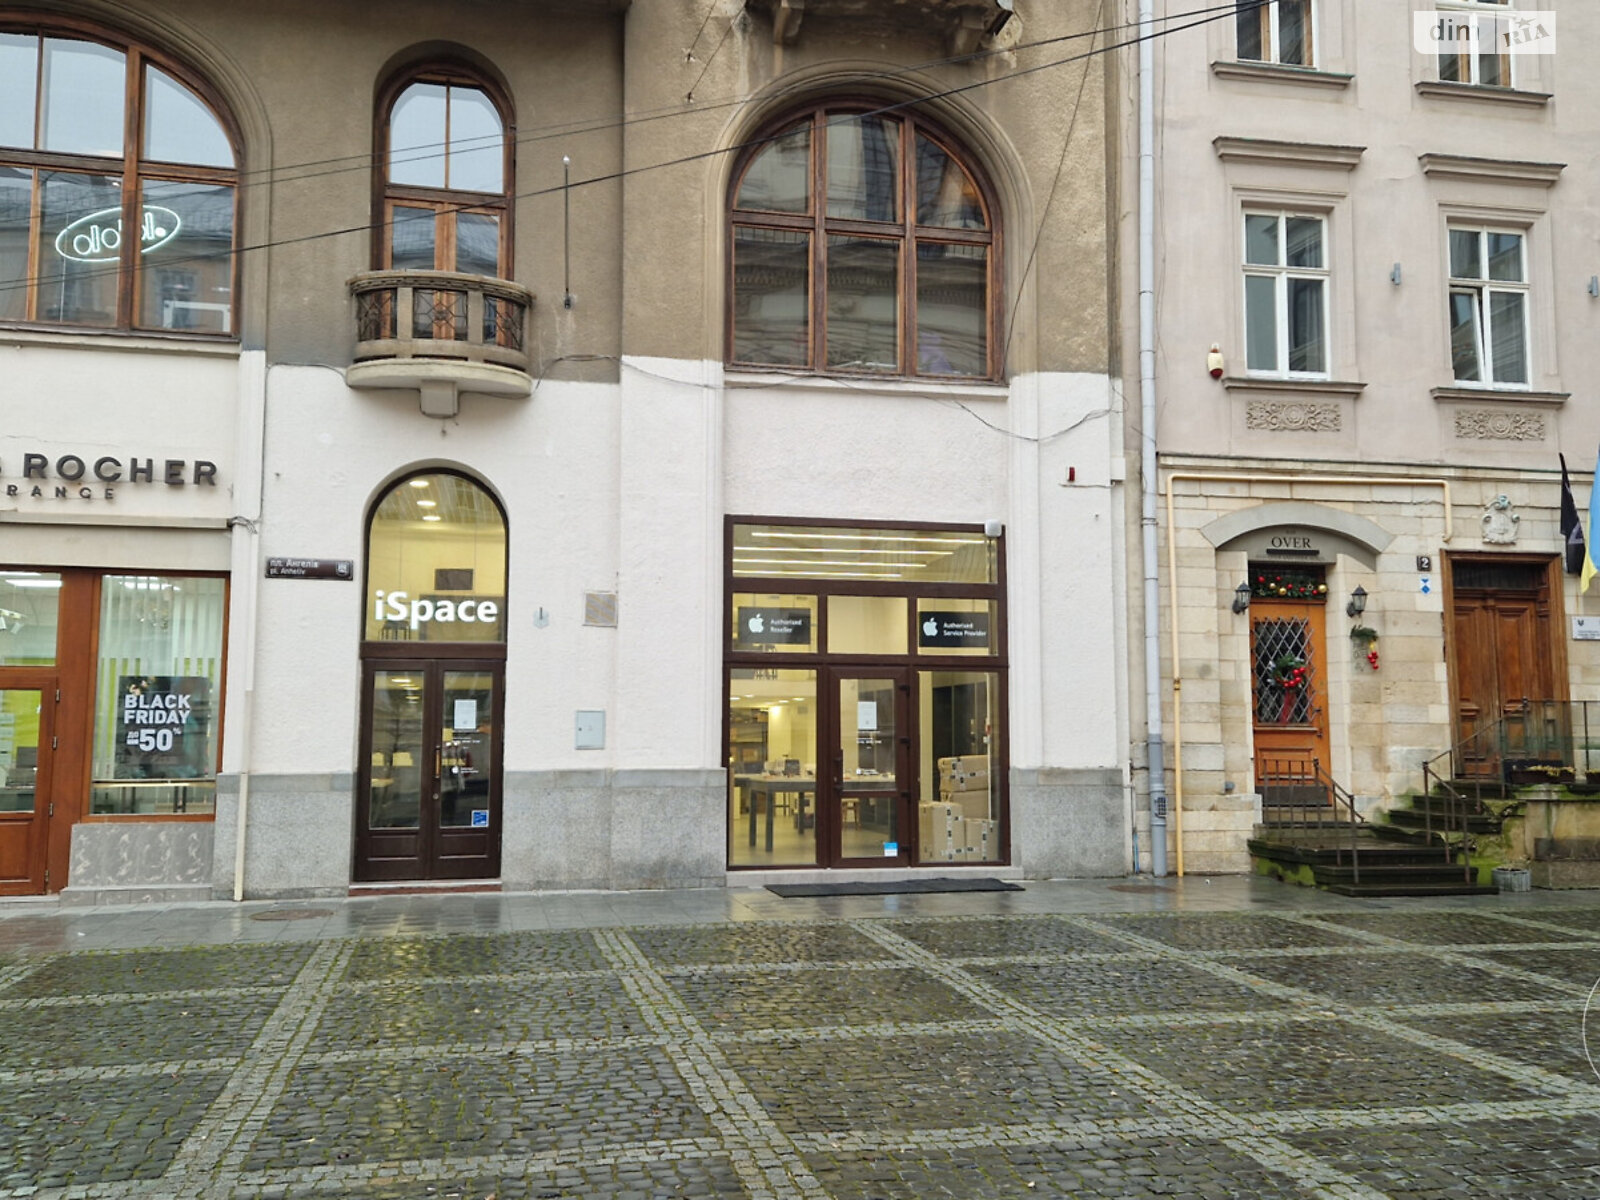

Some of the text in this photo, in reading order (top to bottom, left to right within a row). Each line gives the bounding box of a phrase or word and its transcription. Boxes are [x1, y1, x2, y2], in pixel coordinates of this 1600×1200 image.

[23, 453, 217, 486] ROCHER
[1271, 536, 1311, 548] OVER
[1421, 557, 1429, 568] 2
[375, 590, 498, 630] iSpace
[125, 694, 191, 709] BLACK
[124, 710, 190, 724] FRIDAY
